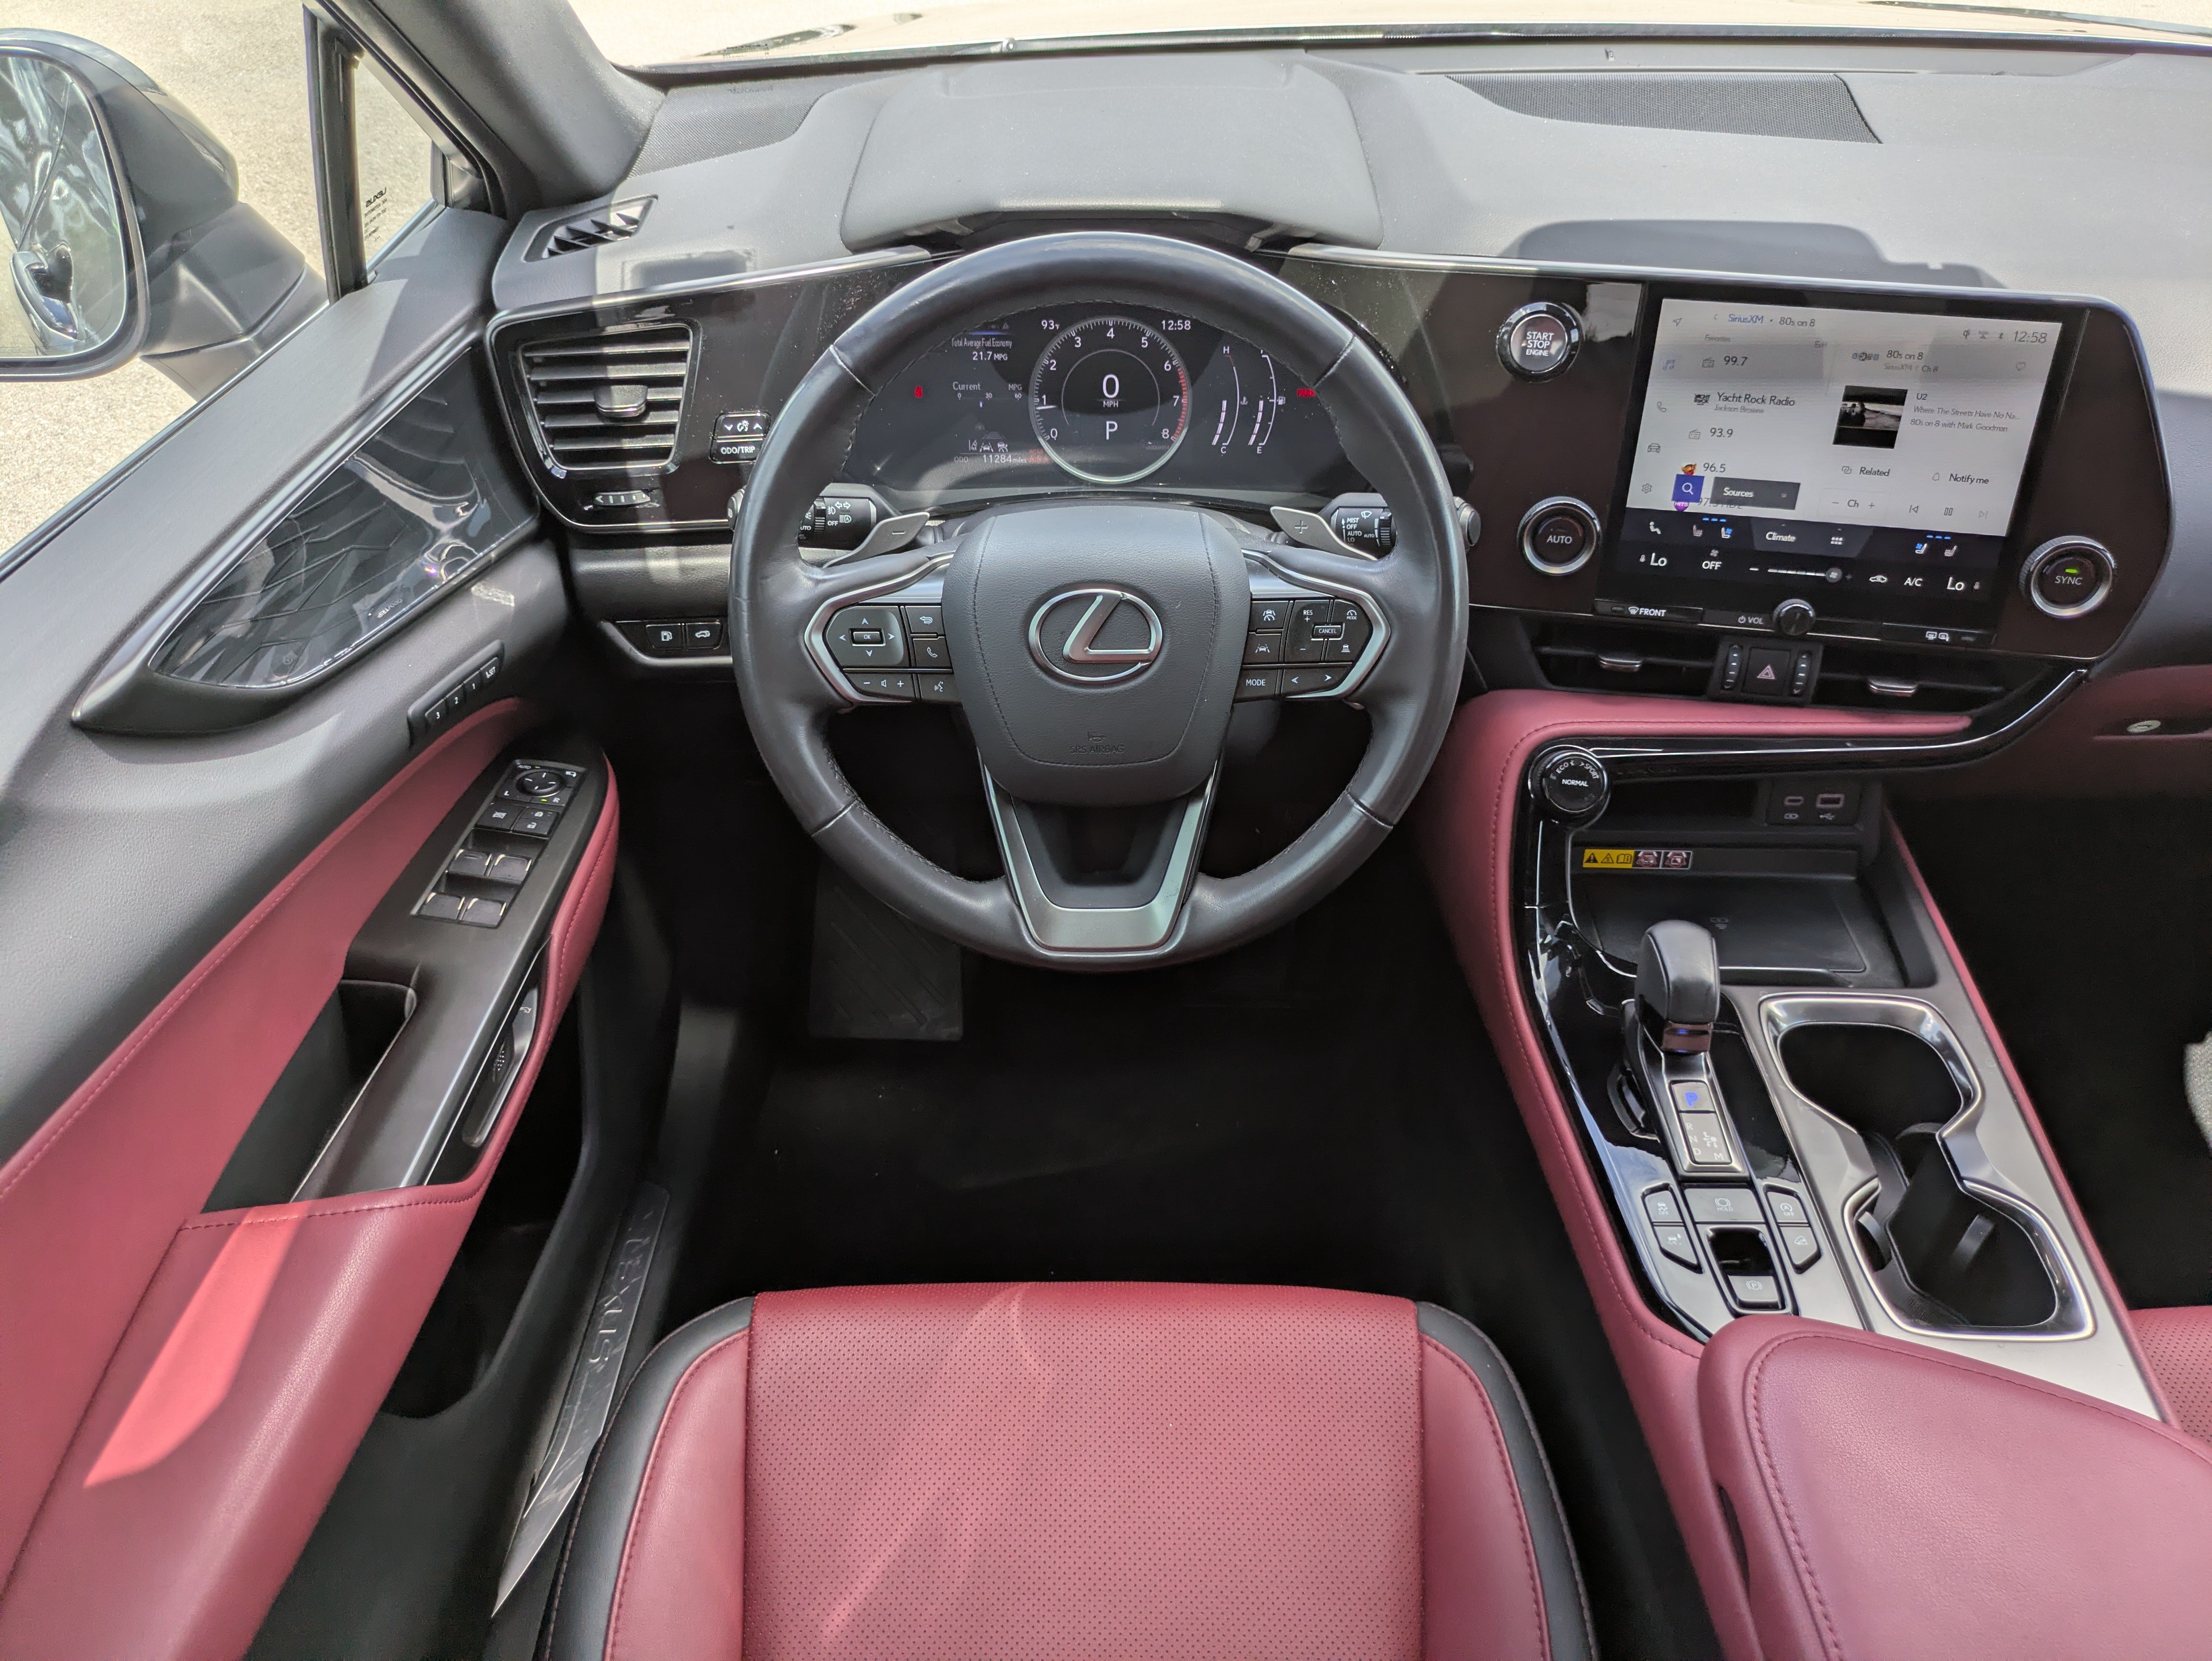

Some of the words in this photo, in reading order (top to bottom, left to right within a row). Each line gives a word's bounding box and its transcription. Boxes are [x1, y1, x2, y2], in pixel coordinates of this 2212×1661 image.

[1161, 320, 1191, 330] 12:58
[1728, 314, 1764, 323] SiriusXM
[1779, 317, 1795, 326] 80s
[1809, 319, 1815, 327] 8
[1106, 328, 1115, 339] 4
[1526, 331, 1554, 341] START
[2013, 330, 2047, 344] 12:58
[951, 338, 963, 347] Total
[963, 338, 981, 349] Average
[982, 338, 992, 347] Fuel
[992, 338, 1012, 349] Economy
[1074, 337, 1082, 348] 3
[1141, 337, 1149, 348] 5
[1527, 340, 1550, 349] STOP
[1223, 346, 1230, 354] H
[1526, 349, 1549, 357] ENGINE
[1886, 350, 1903, 359] 80s
[1917, 352, 1923, 360] 8
[972, 351, 993, 361] 21.7
[1724, 355, 1748, 366] 99.7
[1050, 360, 1057, 371] 2
[1163, 360, 1172, 372] 6
[952, 381, 981, 391] Current
[1102, 374, 1119, 399] 0
[1042, 394, 1047, 405] 1
[1172, 395, 1180, 407] 7
[1717, 392, 1742, 402] Yacht
[1744, 393, 1767, 405] Rock
[1769, 395, 1795, 407] Radio
[1913, 406, 1935, 414] Where
[1951, 408, 1973, 417] Streets
[1106, 421, 1118, 440] P
[1710, 427, 1733, 438] 93.9
[1975, 423, 2008, 432] Goodman
[1050, 428, 1058, 439] 0
[1161, 428, 1170, 439] 8
[720, 446, 755, 455] ODO/TRIP
[1220, 446, 1227, 454] C
[1257, 446, 1262, 454] E
[983, 454, 1011, 463] 11284
[1703, 462, 1726, 473] 96.5
[1859, 466, 1891, 477] Related
[1948, 473, 1975, 485] Notify
[1723, 487, 1754, 498] Sources
[1847, 499, 1859, 508] Ch
[1546, 535, 1573, 544] AUTO
[1765, 532, 1796, 543] Climate
[1650, 553, 1668, 567] Lo
[1702, 561, 1722, 570] OFF
[1903, 577, 1923, 588] A/C
[1947, 577, 1965, 591] Lo
[2054, 575, 2083, 586] SYNC
[1638, 608, 1667, 618] FRONT
[1748, 616, 1764, 625] VOL
[454, 697, 459, 705] 2
[1069, 745, 1088, 754] SRS
[1089, 744, 1125, 754] AIRBAG
[1556, 762, 1569, 774] ECO
[1584, 763, 1600, 779] SPORT
[1561, 778, 1589, 787] NORMAL
[1684, 1091, 1698, 1107] P
[1685, 1122, 1693, 1130] R
[1688, 1135, 1698, 1143] N
[1692, 1147, 1701, 1155] D
[1714, 1152, 1724, 1161] M
